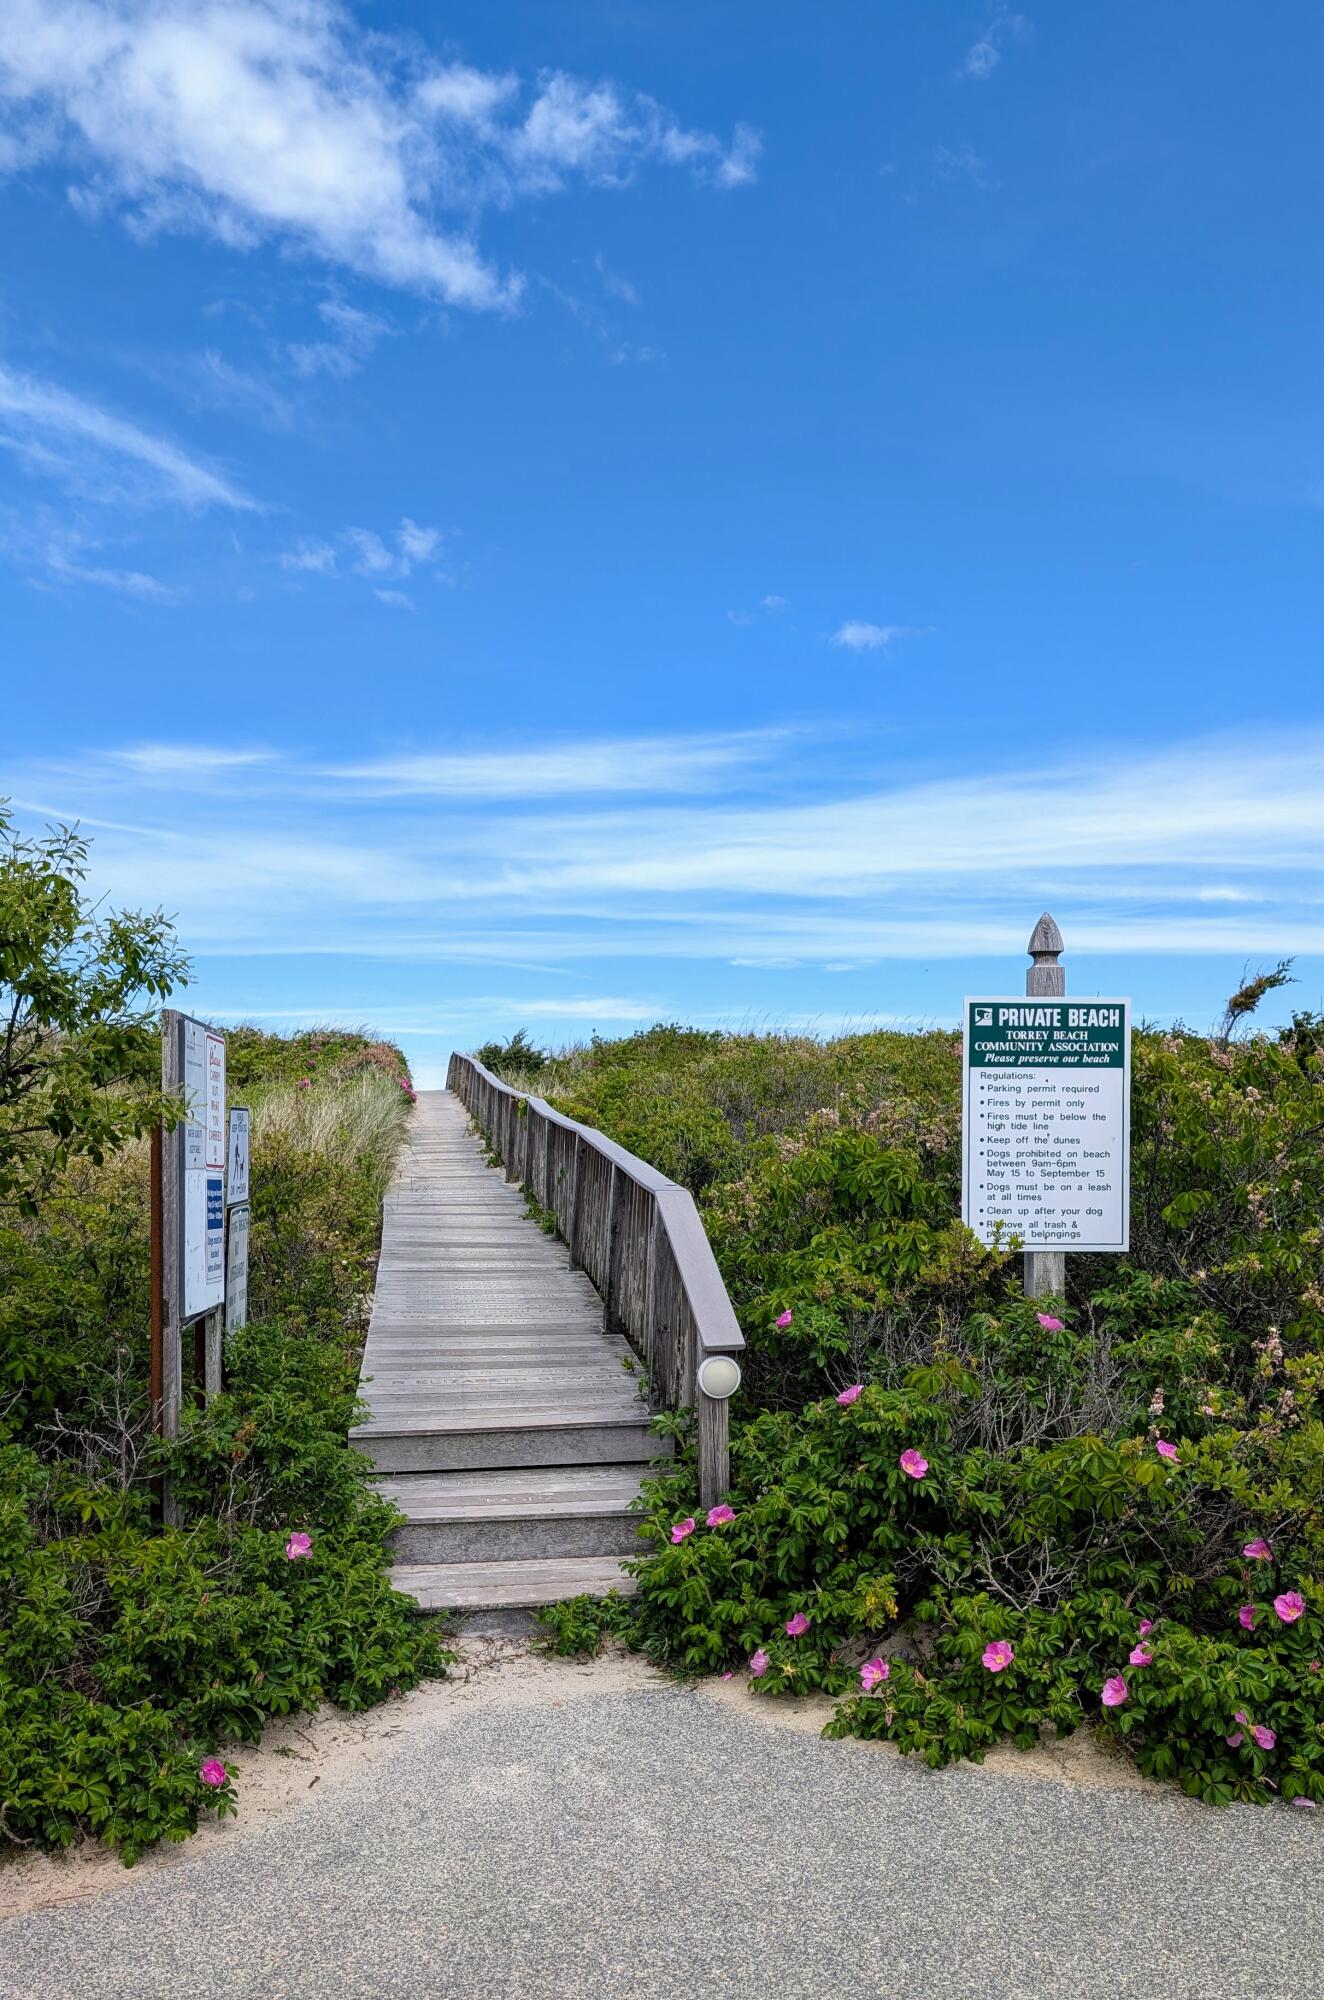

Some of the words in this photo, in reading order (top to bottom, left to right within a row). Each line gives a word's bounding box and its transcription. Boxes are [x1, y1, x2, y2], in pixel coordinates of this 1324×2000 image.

[999, 1008, 1061, 1027] PRIVATE
[1069, 1008, 1119, 1027] BEACH
[1006, 1031, 1049, 1040] TORREY
[1054, 1031, 1088, 1040] BEACH
[975, 1042, 1044, 1052] COMMUNITY
[1048, 1042, 1118, 1052] ASSOCIATION
[984, 1053, 1016, 1063] Please
[1018, 1055, 1058, 1065] preserve
[1063, 1055, 1079, 1063] our
[1083, 1054, 1110, 1063] beach
[980, 1072, 1036, 1081] Regulations:
[987, 1085, 1021, 1094] Parking
[1027, 1085, 1056, 1094] permit
[1062, 1085, 1099, 1094] required
[987, 1099, 1009, 1107] Fires
[1016, 1099, 1026, 1108] by
[1032, 1099, 1060, 1108] permit
[1066, 1099, 1085, 1109] only
[987, 1113, 1009, 1121] Fires
[1016, 1113, 1037, 1121] must
[1043, 1113, 1054, 1121] be
[1060, 1113, 1087, 1121] below
[1093, 1113, 1106, 1121] the
[987, 1122, 1005, 1131] high
[1011, 1122, 1027, 1130] tide
[1033, 1122, 1049, 1130] line
[987, 1136, 1010, 1145] Keep
[1016, 1137, 1028, 1145] off
[1034, 1137, 1048, 1145] the
[1054, 1137, 1081, 1145] dunes
[987, 1150, 1010, 1159] Dogs
[1016, 1150, 1061, 1159] prohibited
[1067, 1150, 1078, 1158] on
[1083, 1150, 1110, 1158] beach
[1032, 1160, 1076, 1169] 9am-6pm
[987, 1170, 1005, 1178] May
[1040, 1170, 1090, 1179] September
[987, 1183, 1010, 1192] Dogs
[1016, 1183, 1038, 1191] must
[1044, 1183, 1055, 1191] be
[1061, 1183, 1072, 1191] on
[1077, 1183, 1083, 1191] a
[1088, 1183, 1111, 1191] leash
[987, 1193, 996, 1201] at
[1001, 1193, 1012, 1201] all
[1017, 1193, 1042, 1201] times
[987, 1207, 1012, 1215] Clean
[1018, 1207, 1029, 1216] up
[1035, 1207, 1055, 1215] after
[1061, 1207, 1080, 1216] your
[1086, 1207, 1103, 1216] dog
[987, 1221, 1023, 1229] Rove
[1029, 1221, 1038, 1229] all
[1044, 1221, 1067, 1229] trash
[1072, 1221, 1077, 1229] &
[987, 1230, 1025, 1239] psonal
[1031, 1230, 1081, 1240] belongings
